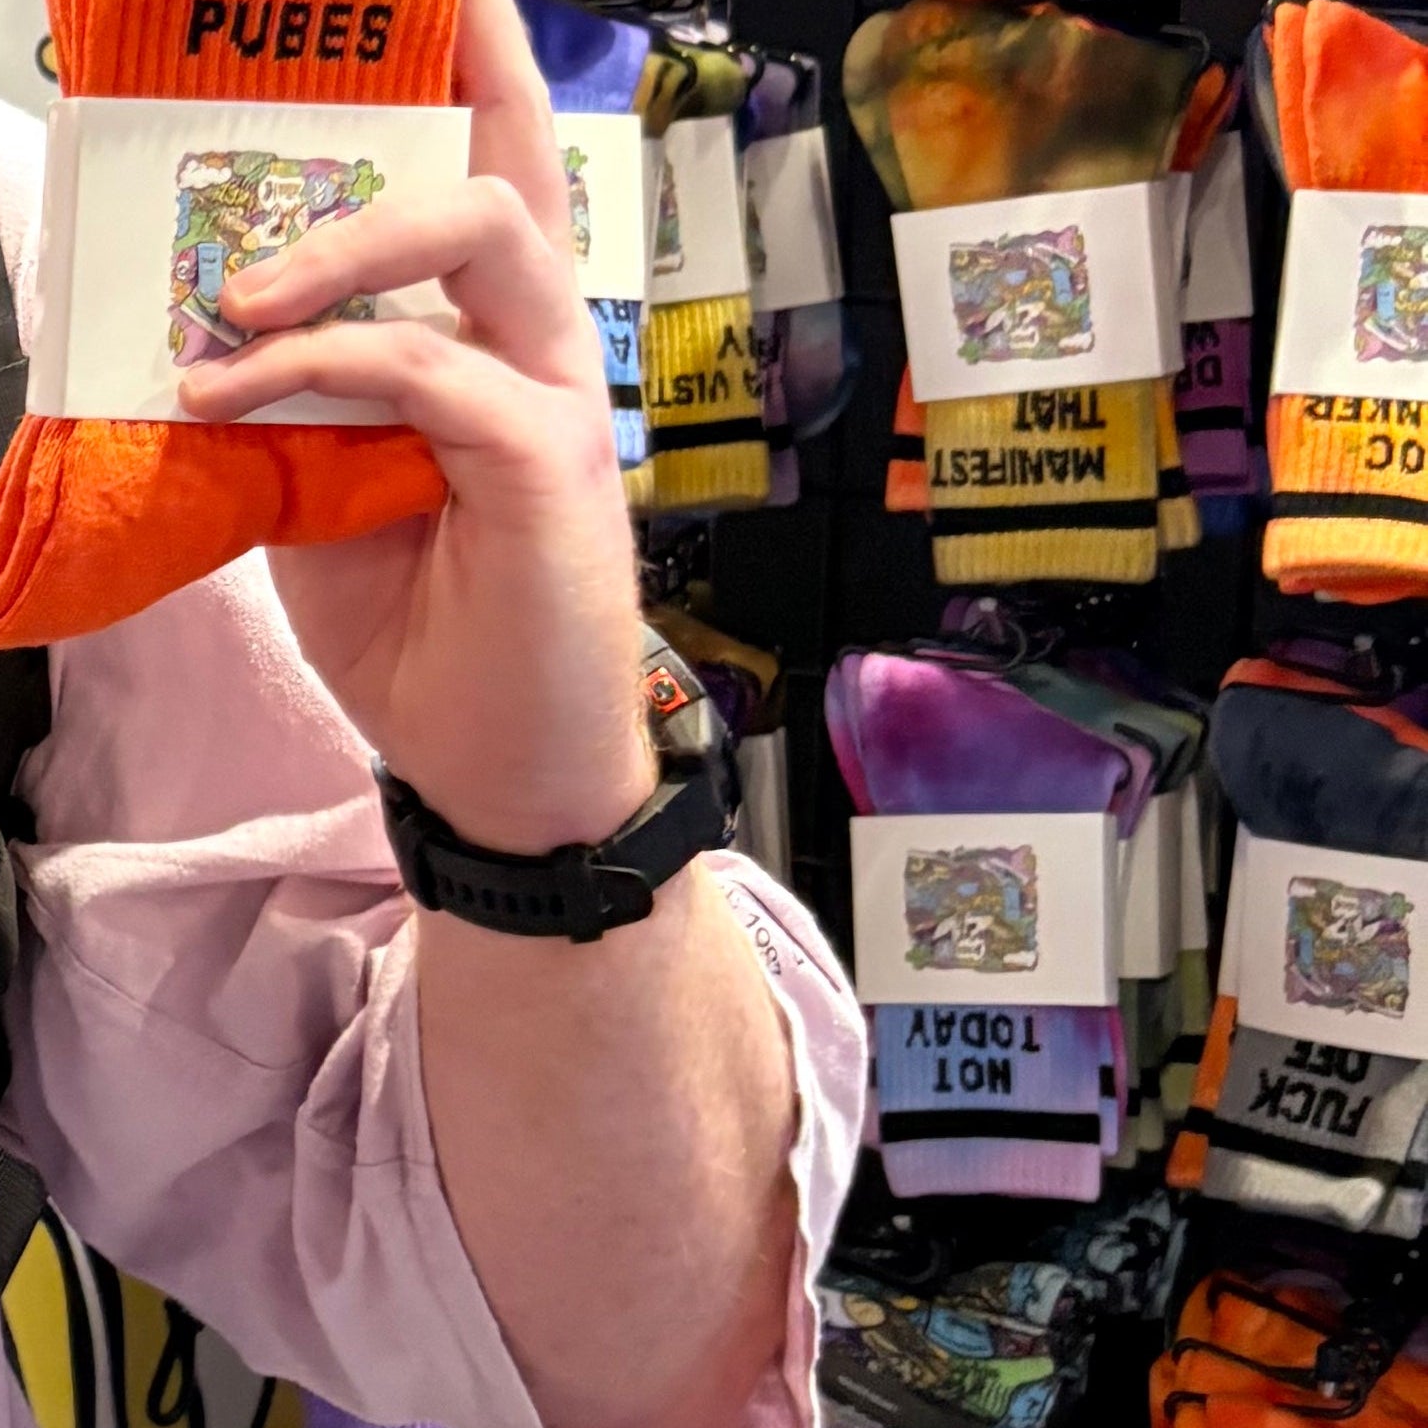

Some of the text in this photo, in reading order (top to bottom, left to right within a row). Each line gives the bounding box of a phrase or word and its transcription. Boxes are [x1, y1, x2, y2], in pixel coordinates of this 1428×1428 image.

[647, 369, 732, 410] VIST
[1013, 388, 1108, 433] THAT
[928, 445, 1108, 488] MANIFEST
[904, 1007, 1041, 1055] TODAY
[931, 1056, 1013, 1095] NOT
[1282, 1039, 1373, 1085] OFF
[1247, 1067, 1373, 1138] FUCK
